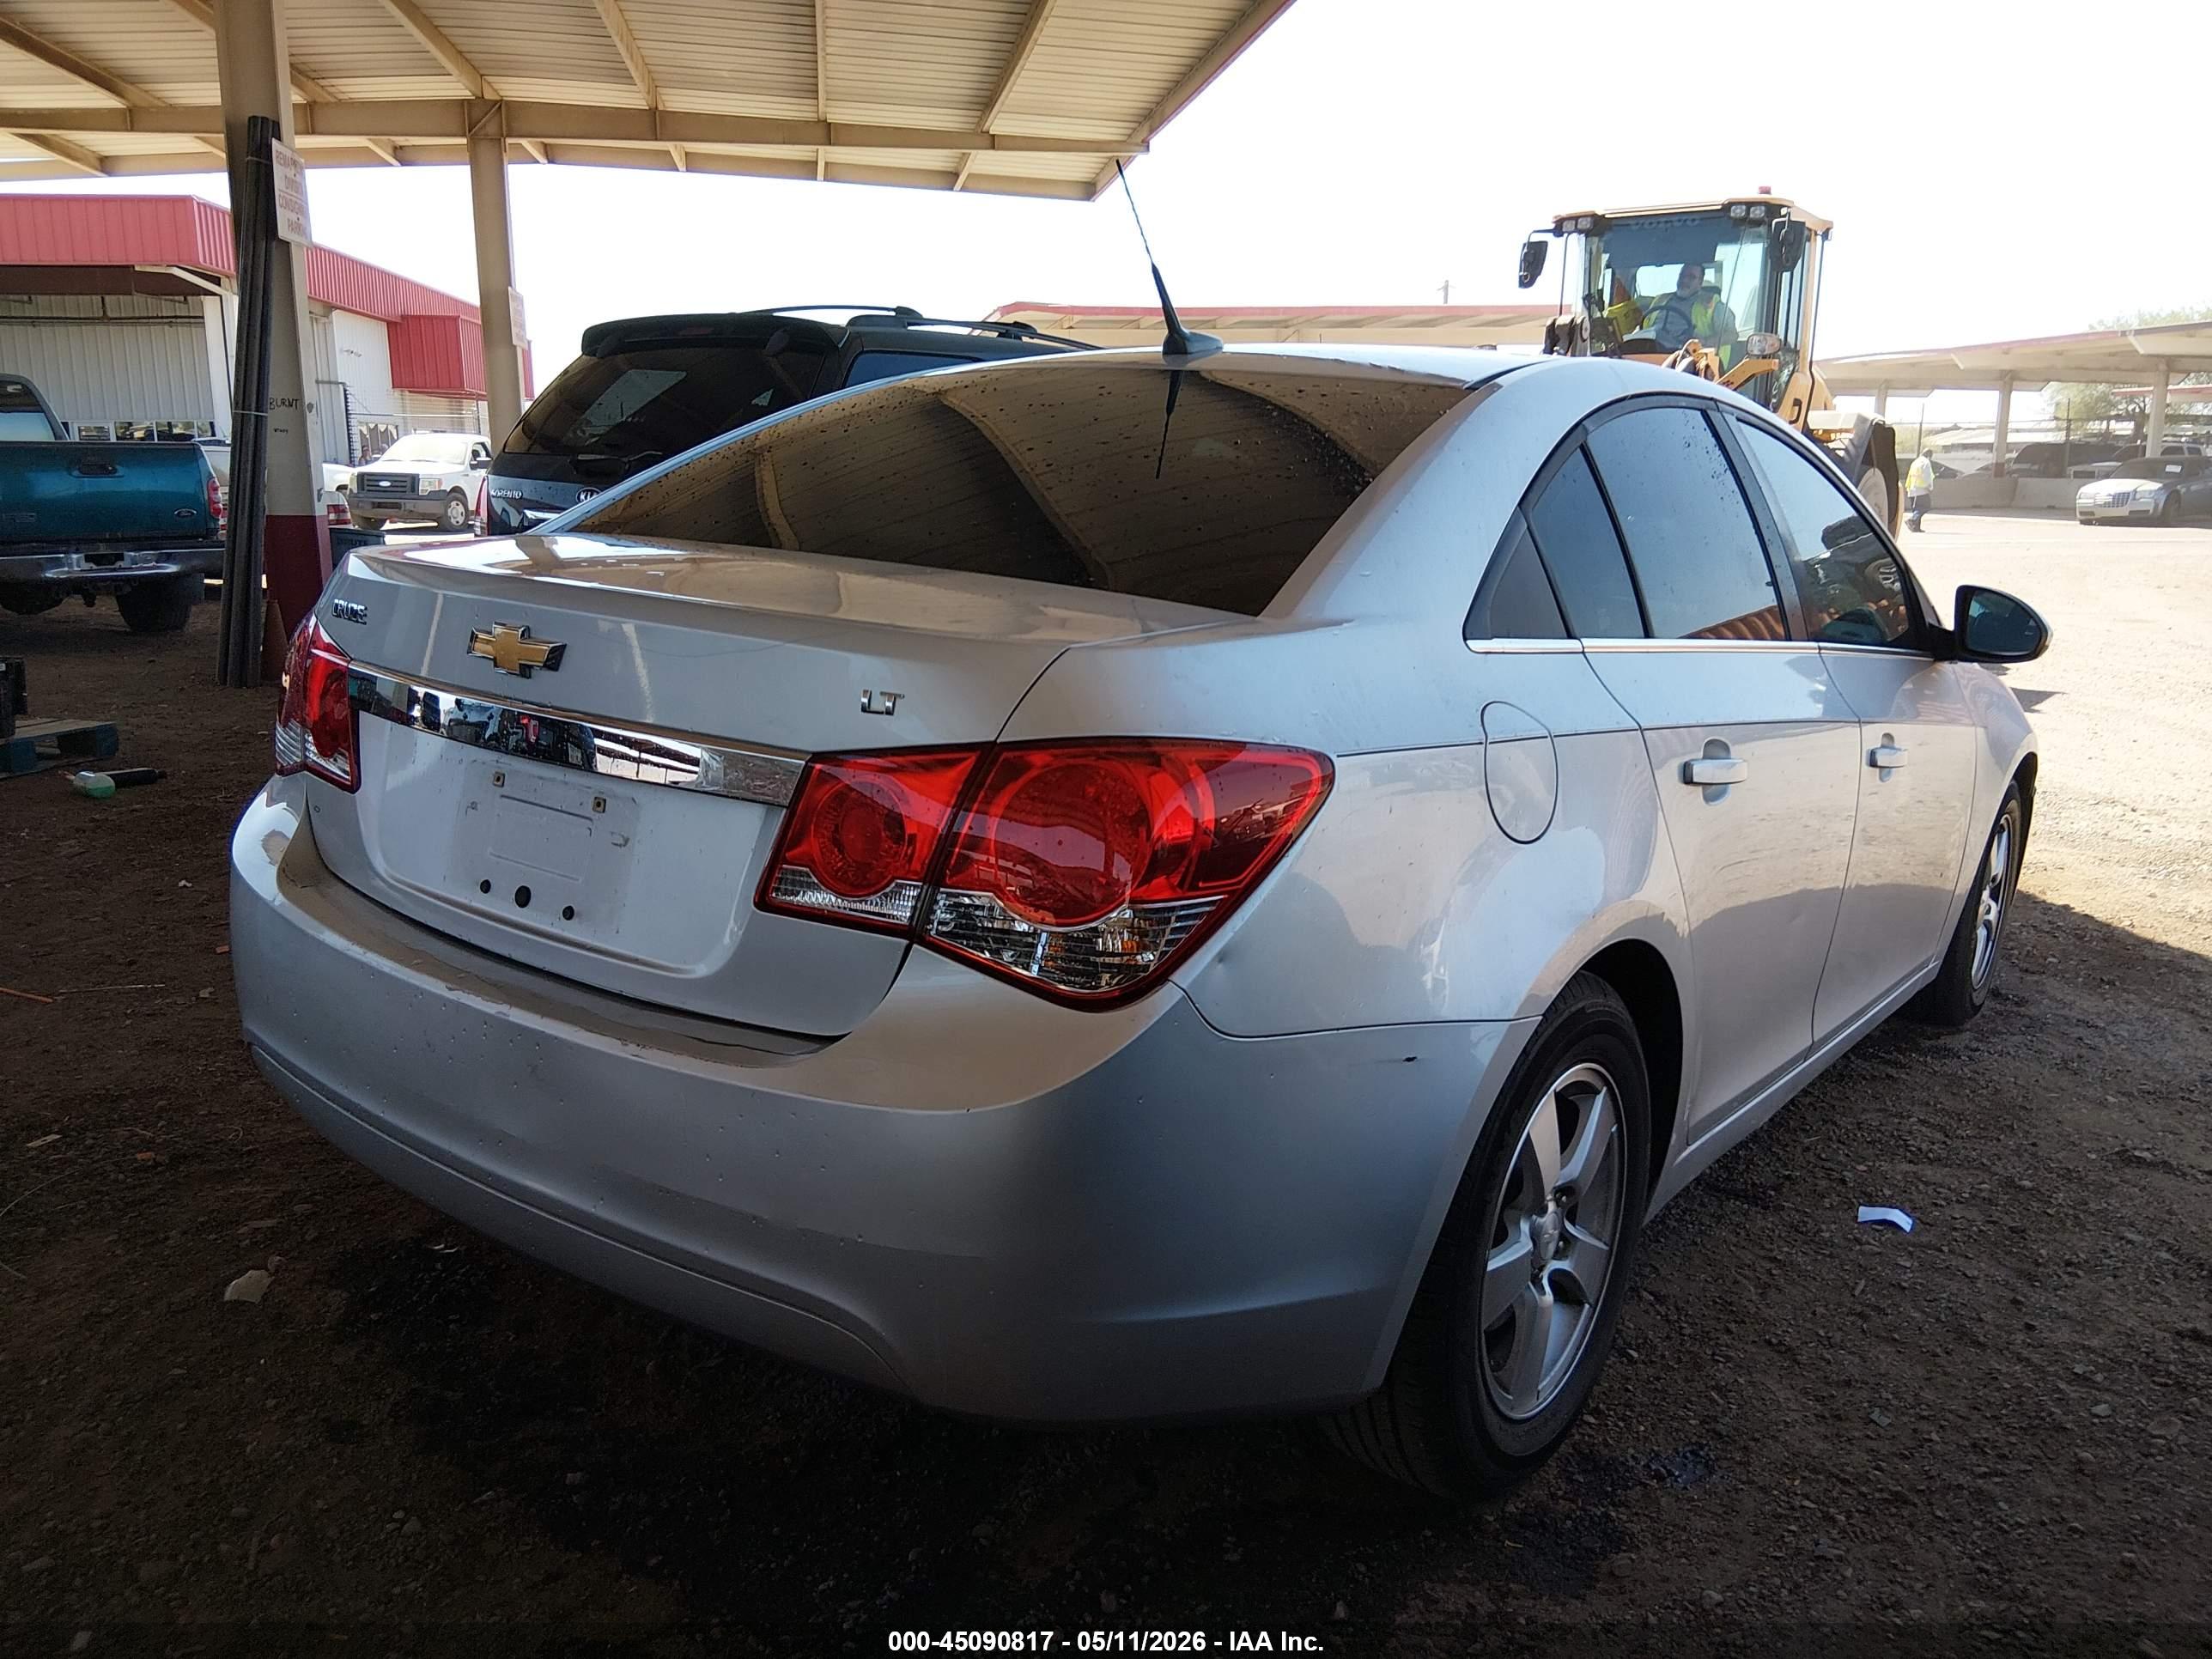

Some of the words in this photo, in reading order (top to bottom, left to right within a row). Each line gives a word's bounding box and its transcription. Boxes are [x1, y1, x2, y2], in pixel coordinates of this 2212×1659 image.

[269, 397, 301, 410] BURNT
[332, 599, 368, 625] CRUZE
[860, 689, 905, 716] LT
